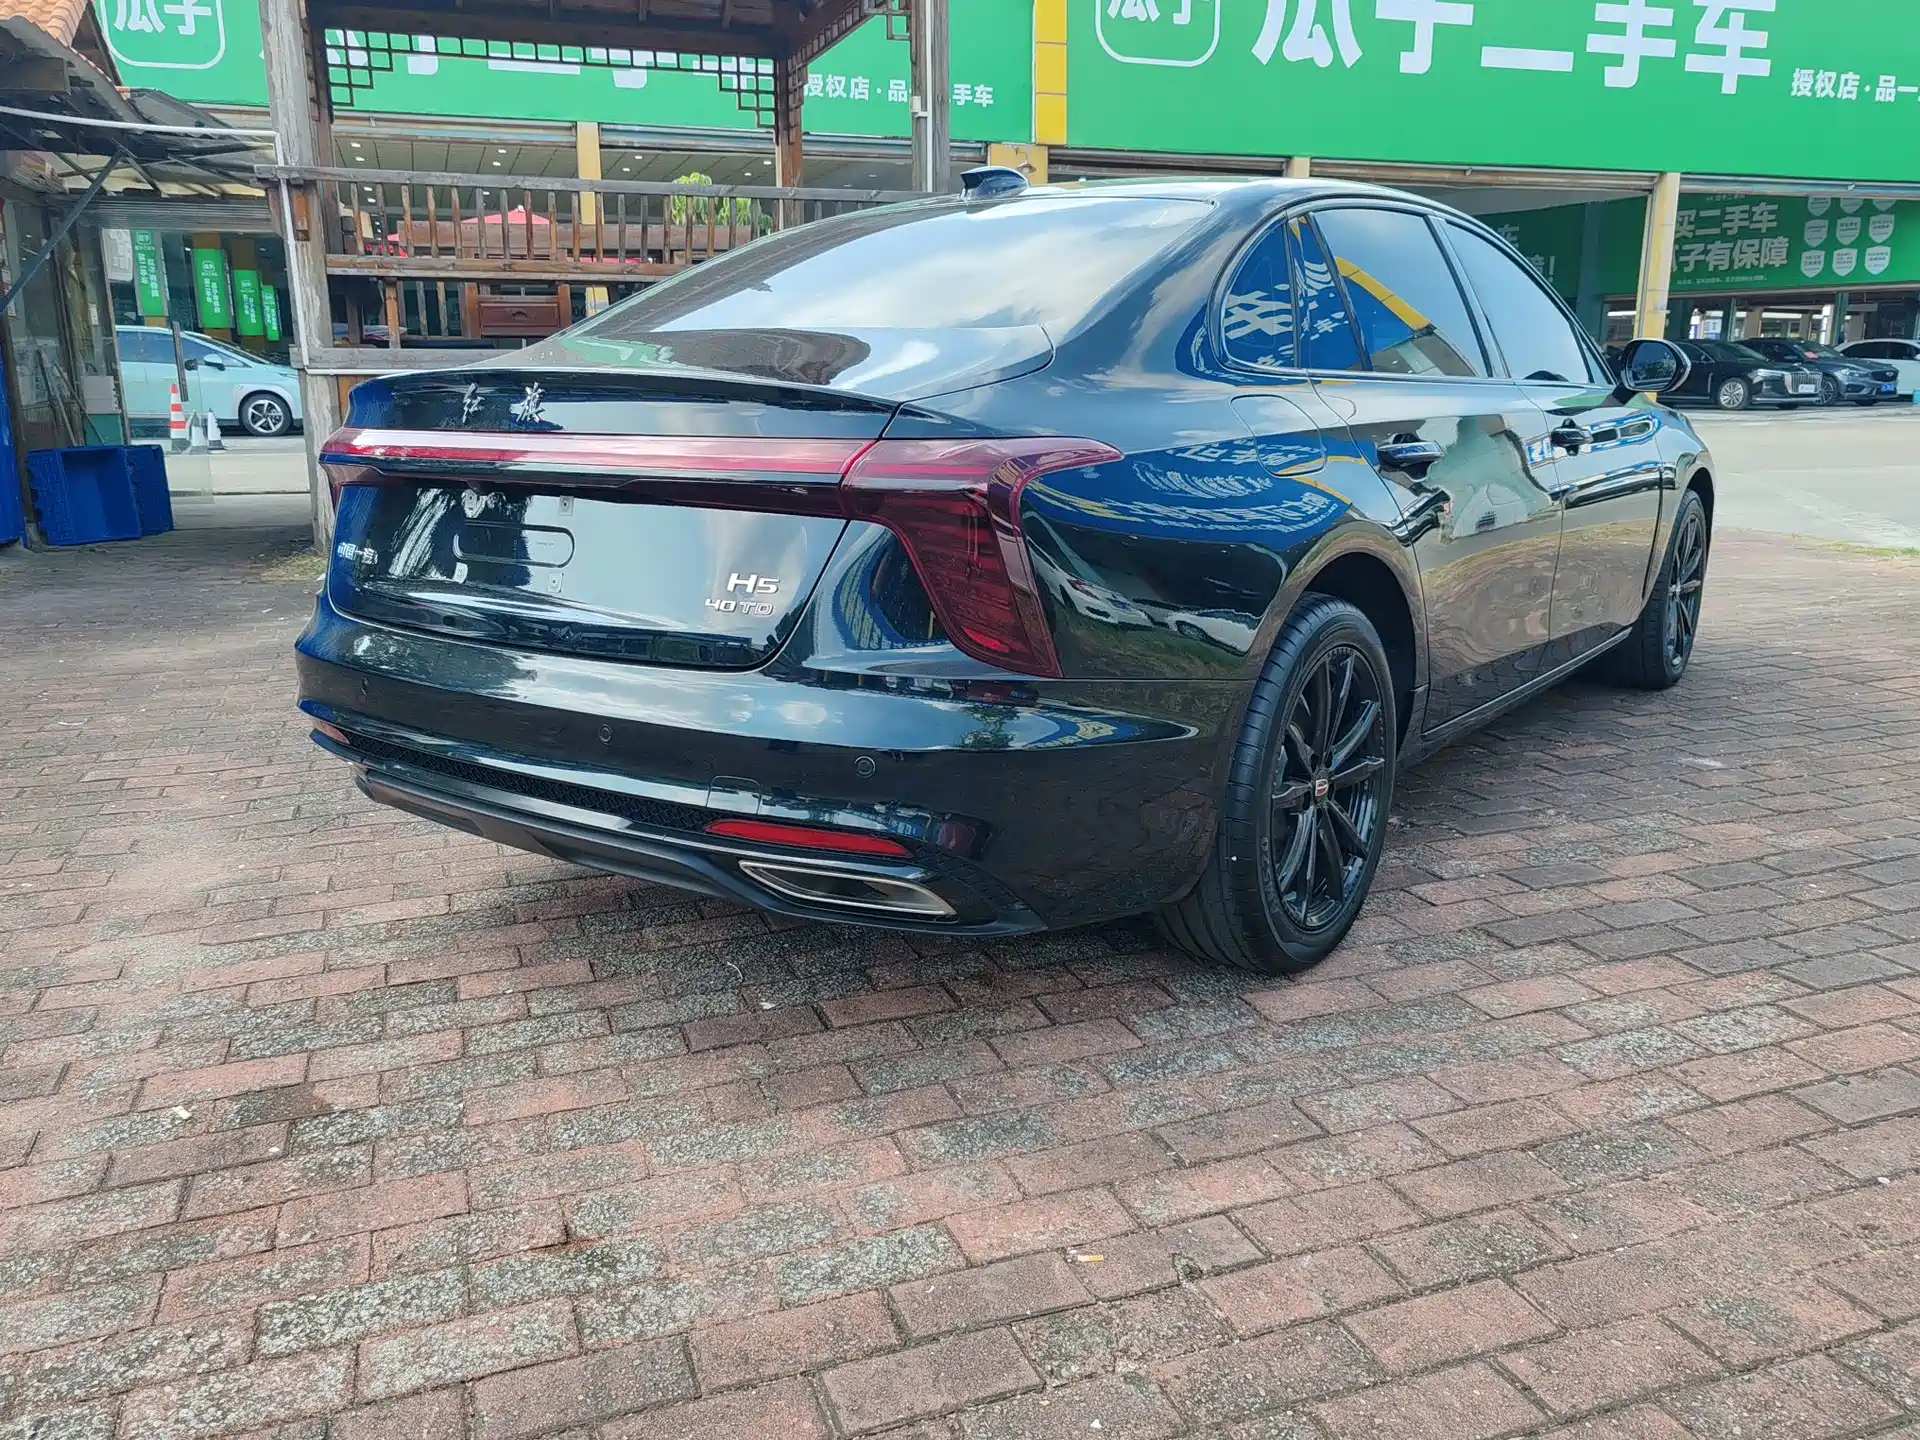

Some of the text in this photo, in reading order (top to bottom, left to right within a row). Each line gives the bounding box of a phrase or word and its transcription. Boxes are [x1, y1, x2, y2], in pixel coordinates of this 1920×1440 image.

[1791, 68, 1919, 102] 授权店·品一
[727, 573, 780, 594] H5
